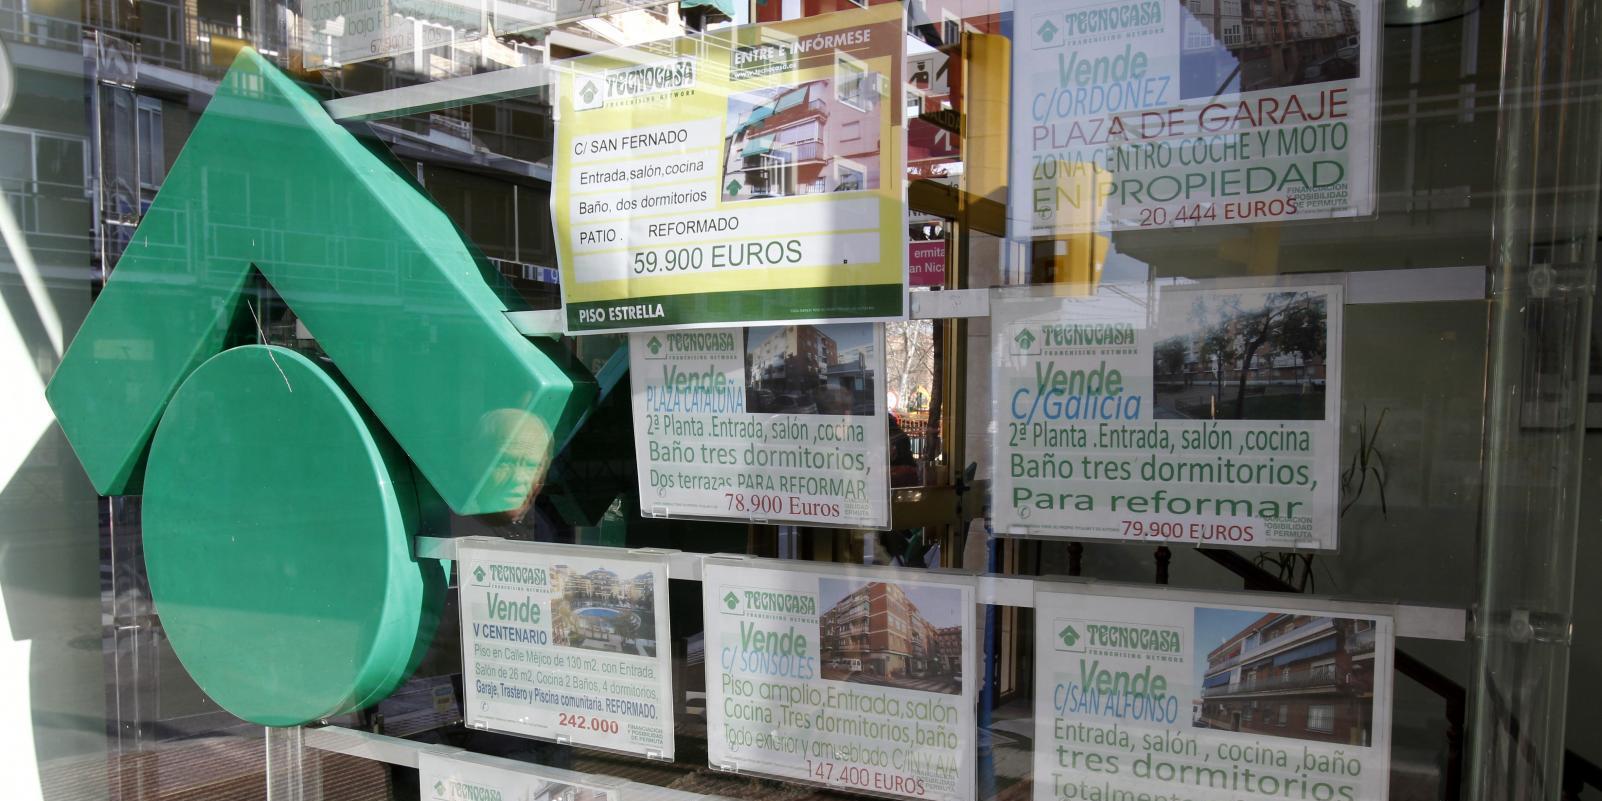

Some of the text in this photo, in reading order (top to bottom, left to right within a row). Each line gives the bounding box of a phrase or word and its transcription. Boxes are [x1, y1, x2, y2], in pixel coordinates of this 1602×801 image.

[1065, 0, 1162, 36] TECNOCASA
[734, 28, 871, 65] ENTRE E INFÓRMESE
[606, 61, 694, 97] TECNOCASA
[1058, 43, 1149, 89] Vende
[1031, 87, 1349, 151] PLAZA DE GARAJE
[574, 128, 688, 156] C/ SAN FERNADO
[1032, 121, 1349, 182] ZONA CENTRO COCHE Y MOTO
[579, 189, 708, 215] Baño, dos dormitorios
[1032, 159, 1346, 214] EN PROPIEDAD
[1139, 198, 1298, 227] 20.444 EUROS
[580, 216, 739, 245] PATIO REFORMADO
[633, 239, 803, 274] 59.900 EUROS
[578, 303, 665, 323] PISO ESTRELLA
[666, 332, 735, 352] TECNOCASA
[1041, 323, 1135, 348] TECNOCASA
[662, 363, 727, 395] Vende
[1035, 360, 1123, 397] Vende
[646, 379, 744, 415] PLAZA CATALUÑA
[1010, 384, 1142, 425] C/Galicia
[646, 413, 660, 437] 2ª
[664, 414, 704, 437] Planta
[771, 416, 809, 441] salón
[1008, 422, 1027, 447] 2ª
[1033, 422, 1087, 448] Planta
[1181, 421, 1233, 451] salón
[649, 440, 871, 476] Baño tres dormitorios,
[1010, 452, 1318, 491] Baño tres dormitorios,
[649, 469, 674, 489] Dos
[677, 472, 732, 490] terrazas
[737, 473, 775, 491] PARA
[724, 492, 783, 515] 78.900
[789, 497, 840, 518] Euros
[1012, 487, 1303, 519] Para reformar
[1121, 520, 1184, 540] 79.900
[1189, 522, 1254, 542] EUROS
[489, 564, 547, 586] TECNOCASA
[486, 591, 541, 625] Vende
[743, 590, 816, 616] TECNOCASA
[472, 623, 547, 646] V CENTENARIO
[740, 620, 807, 657] Vende
[1086, 623, 1181, 653] TECNOCASA
[474, 643, 491, 658] Piso
[492, 648, 503, 659] en
[504, 647, 525, 662] Calle
[526, 650, 552, 668] Méjico
[554, 655, 564, 667] de
[566, 657, 582, 670] 130
[601, 662, 617, 674] con
[721, 645, 815, 681] C/ SONSOLES
[474, 662, 496, 677] Salón
[497, 665, 508, 679] de
[508, 666, 519, 681] 26
[536, 671, 564, 688] Cocina
[565, 675, 571, 688] 2
[602, 680, 608, 692] 4
[722, 672, 754, 697] Piso
[1079, 657, 1168, 701] Vende
[500, 682, 528, 701] Trastero
[528, 690, 533, 705] y
[534, 687, 560, 705] Piscina
[1053, 682, 1178, 725] C/SAN ALFONSO
[558, 712, 620, 735] 242.000
[723, 697, 773, 725] Cocina
[723, 723, 753, 748] Todo
[755, 731, 797, 755] exterior
[801, 740, 809, 760] y
[811, 739, 889, 770] amueblado
[1054, 716, 1136, 753] Entrada,
[1142, 731, 1198, 756] salón
[1217, 740, 1288, 769] cocina
[806, 759, 870, 788] 147.400
[874, 772, 926, 796] EUROS
[1055, 744, 1354, 801] tres dormitorios
